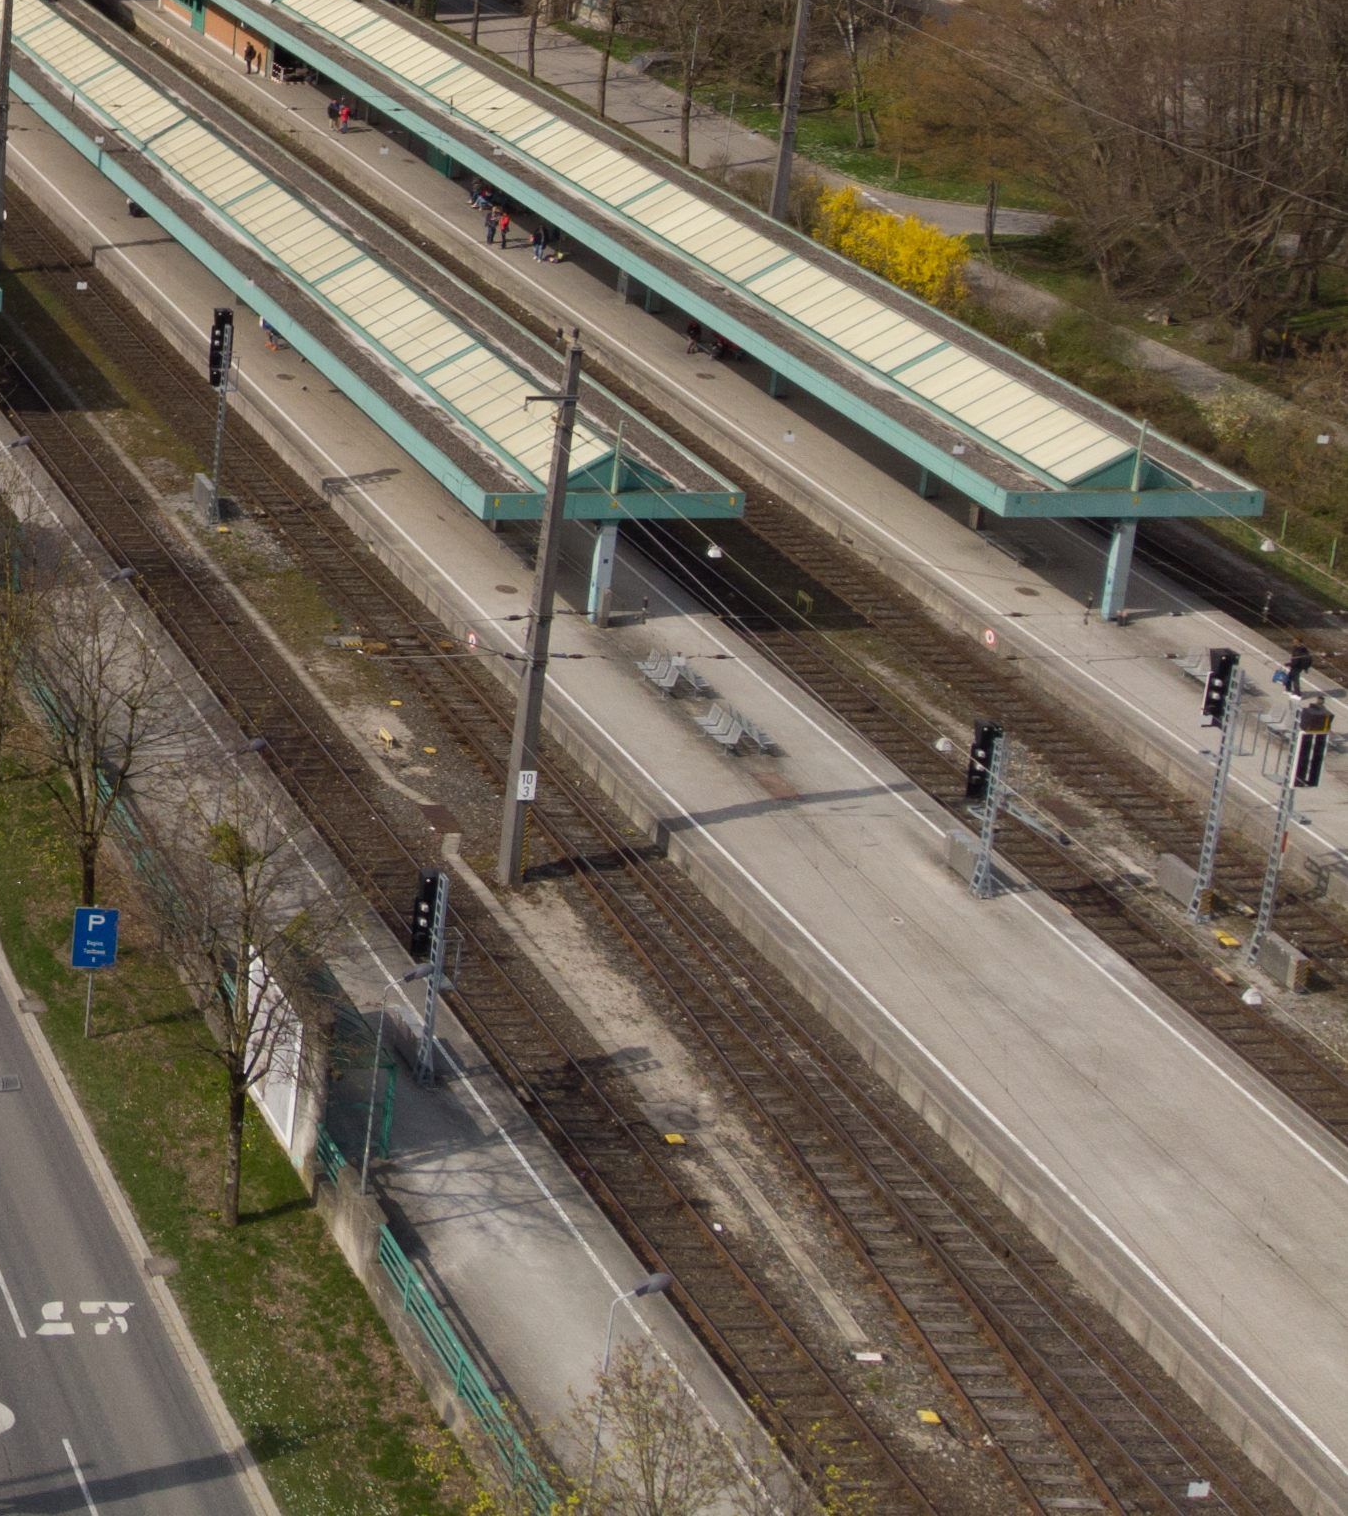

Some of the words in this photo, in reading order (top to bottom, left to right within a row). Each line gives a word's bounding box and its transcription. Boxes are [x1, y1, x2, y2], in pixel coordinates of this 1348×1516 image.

[522, 773, 534, 785] 10
[522, 786, 530, 798] 3
[87, 914, 106, 932] P
